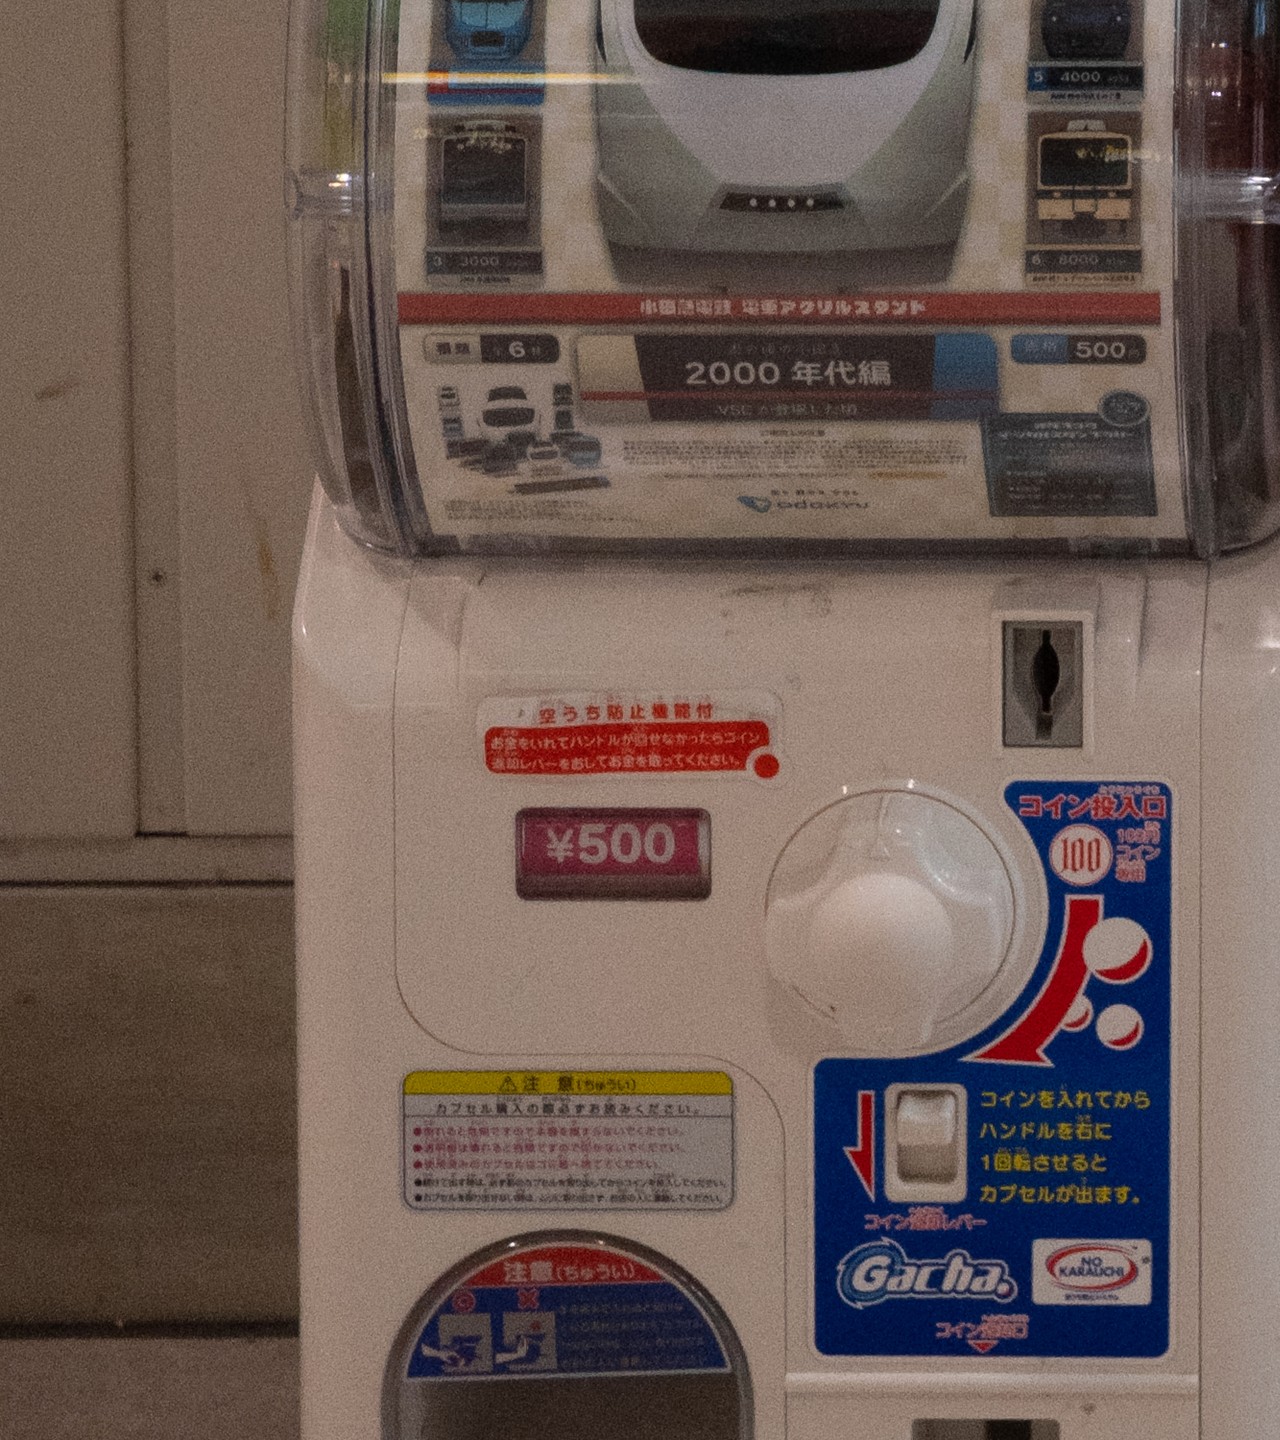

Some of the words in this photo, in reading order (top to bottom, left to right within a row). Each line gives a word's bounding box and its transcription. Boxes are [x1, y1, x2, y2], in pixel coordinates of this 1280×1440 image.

[1034, 72, 1044, 83] 5
[1060, 71, 1101, 83] 4000
[685, 361, 780, 386] 2000
[792, 360, 892, 386] 年代編
[1019, 795, 1167, 819] コイン投入口
[547, 822, 676, 864] ¥500
[1060, 837, 1102, 873] 100
[981, 1091, 1151, 1110] コインを入れてから
[980, 1122, 1112, 1141] ハンドルを右に
[981, 1153, 1107, 1172] 1回転させると
[980, 1185, 1141, 1204] カプセルが出ます。
[1080, 1256, 1104, 1267] NO
[1059, 1267, 1125, 1278] KARAUCHI
